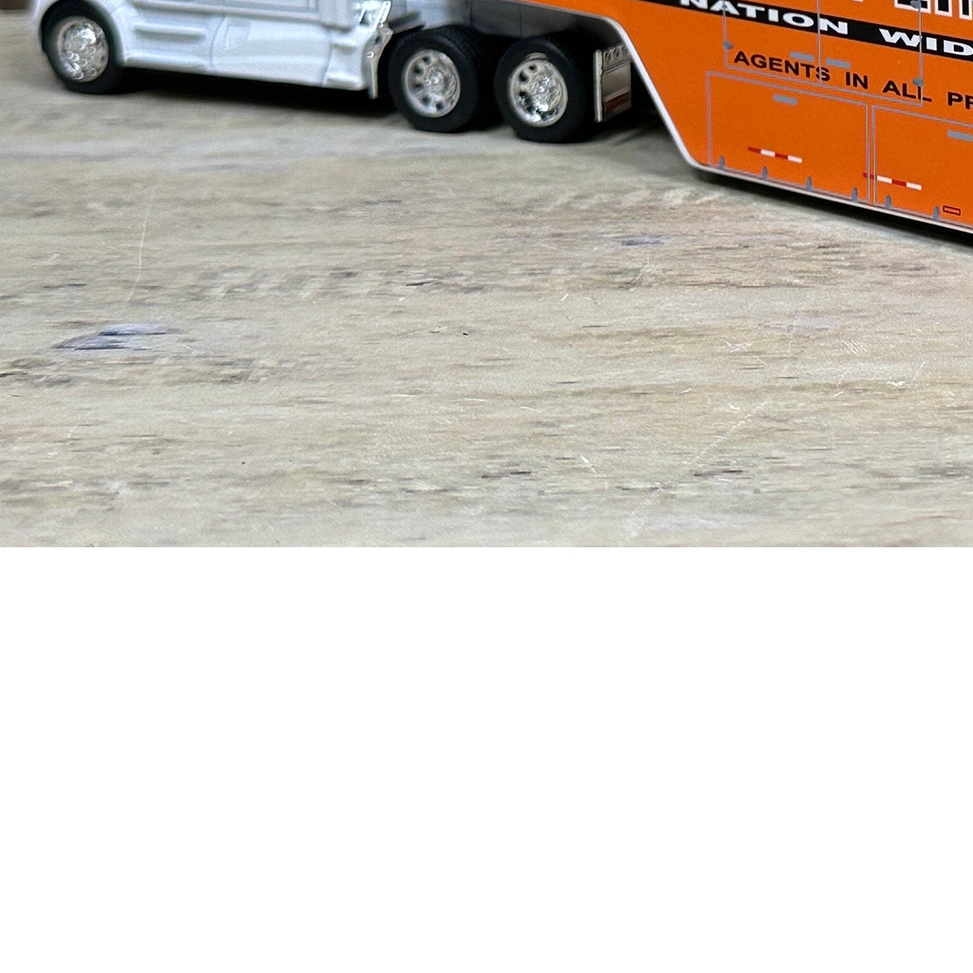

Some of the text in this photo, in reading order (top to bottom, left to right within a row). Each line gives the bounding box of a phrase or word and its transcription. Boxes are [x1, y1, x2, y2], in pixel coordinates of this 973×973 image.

[733, 51, 830, 82] AGENTS
[845, 72, 868, 90] IN
[882, 80, 932, 102] ALL
